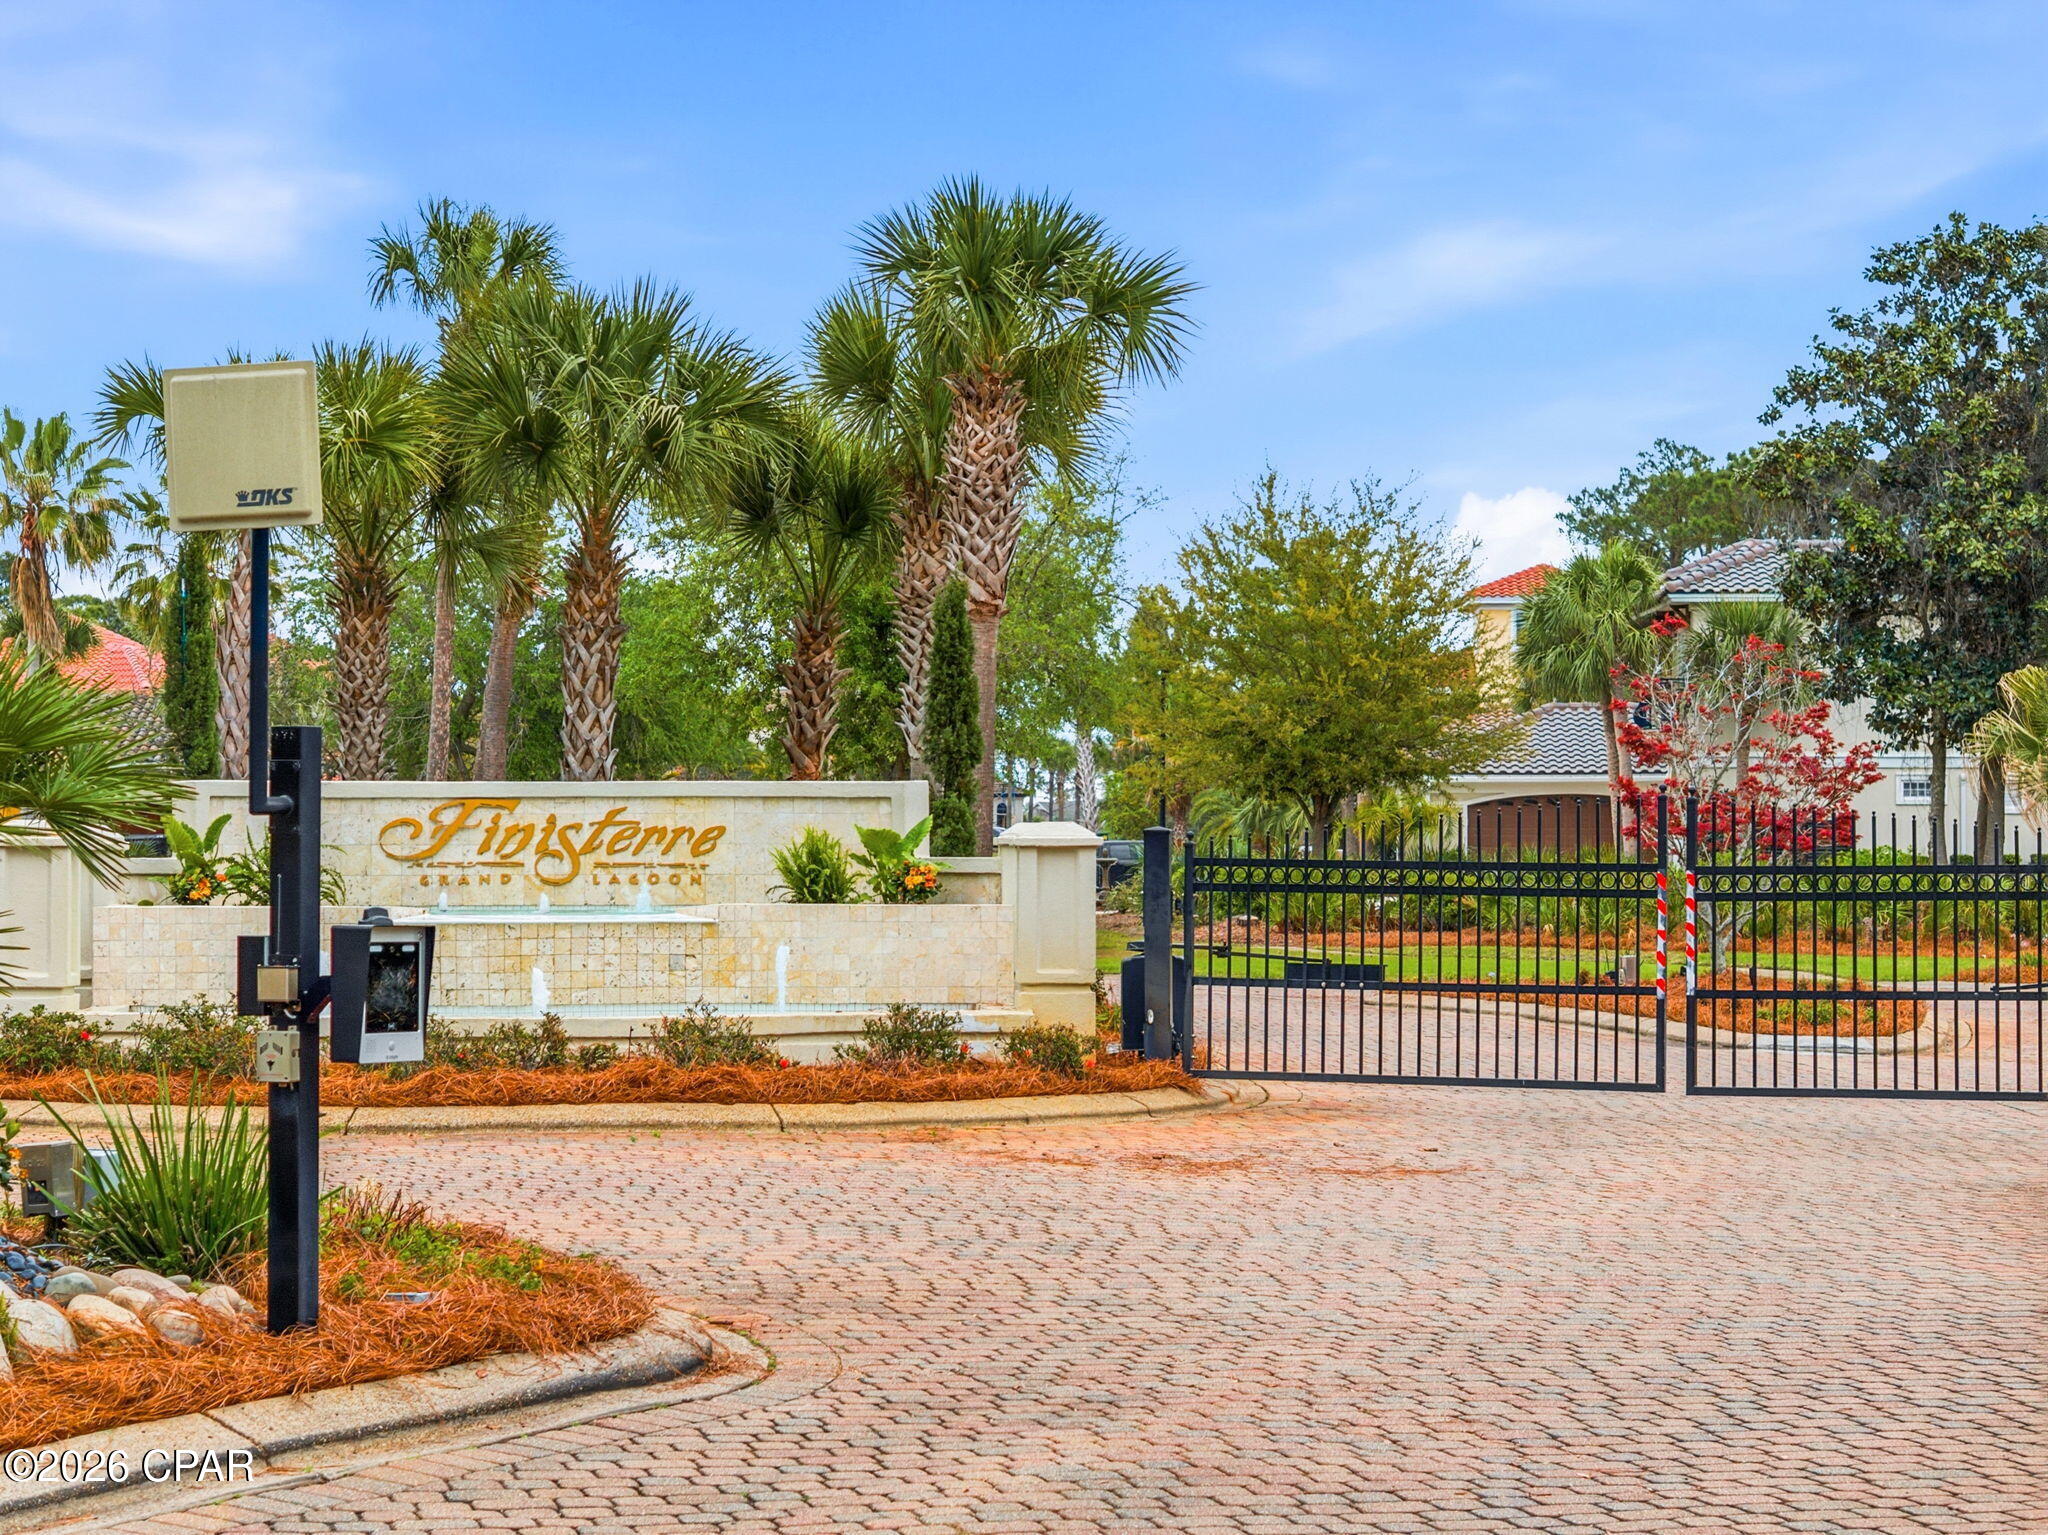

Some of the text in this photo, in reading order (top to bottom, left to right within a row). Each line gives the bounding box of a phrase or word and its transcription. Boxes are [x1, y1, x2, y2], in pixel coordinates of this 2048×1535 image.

[237, 488, 294, 507] DKS
[379, 798, 727, 886] Finisterre
[419, 873, 703, 887] GRAND LAGOON
